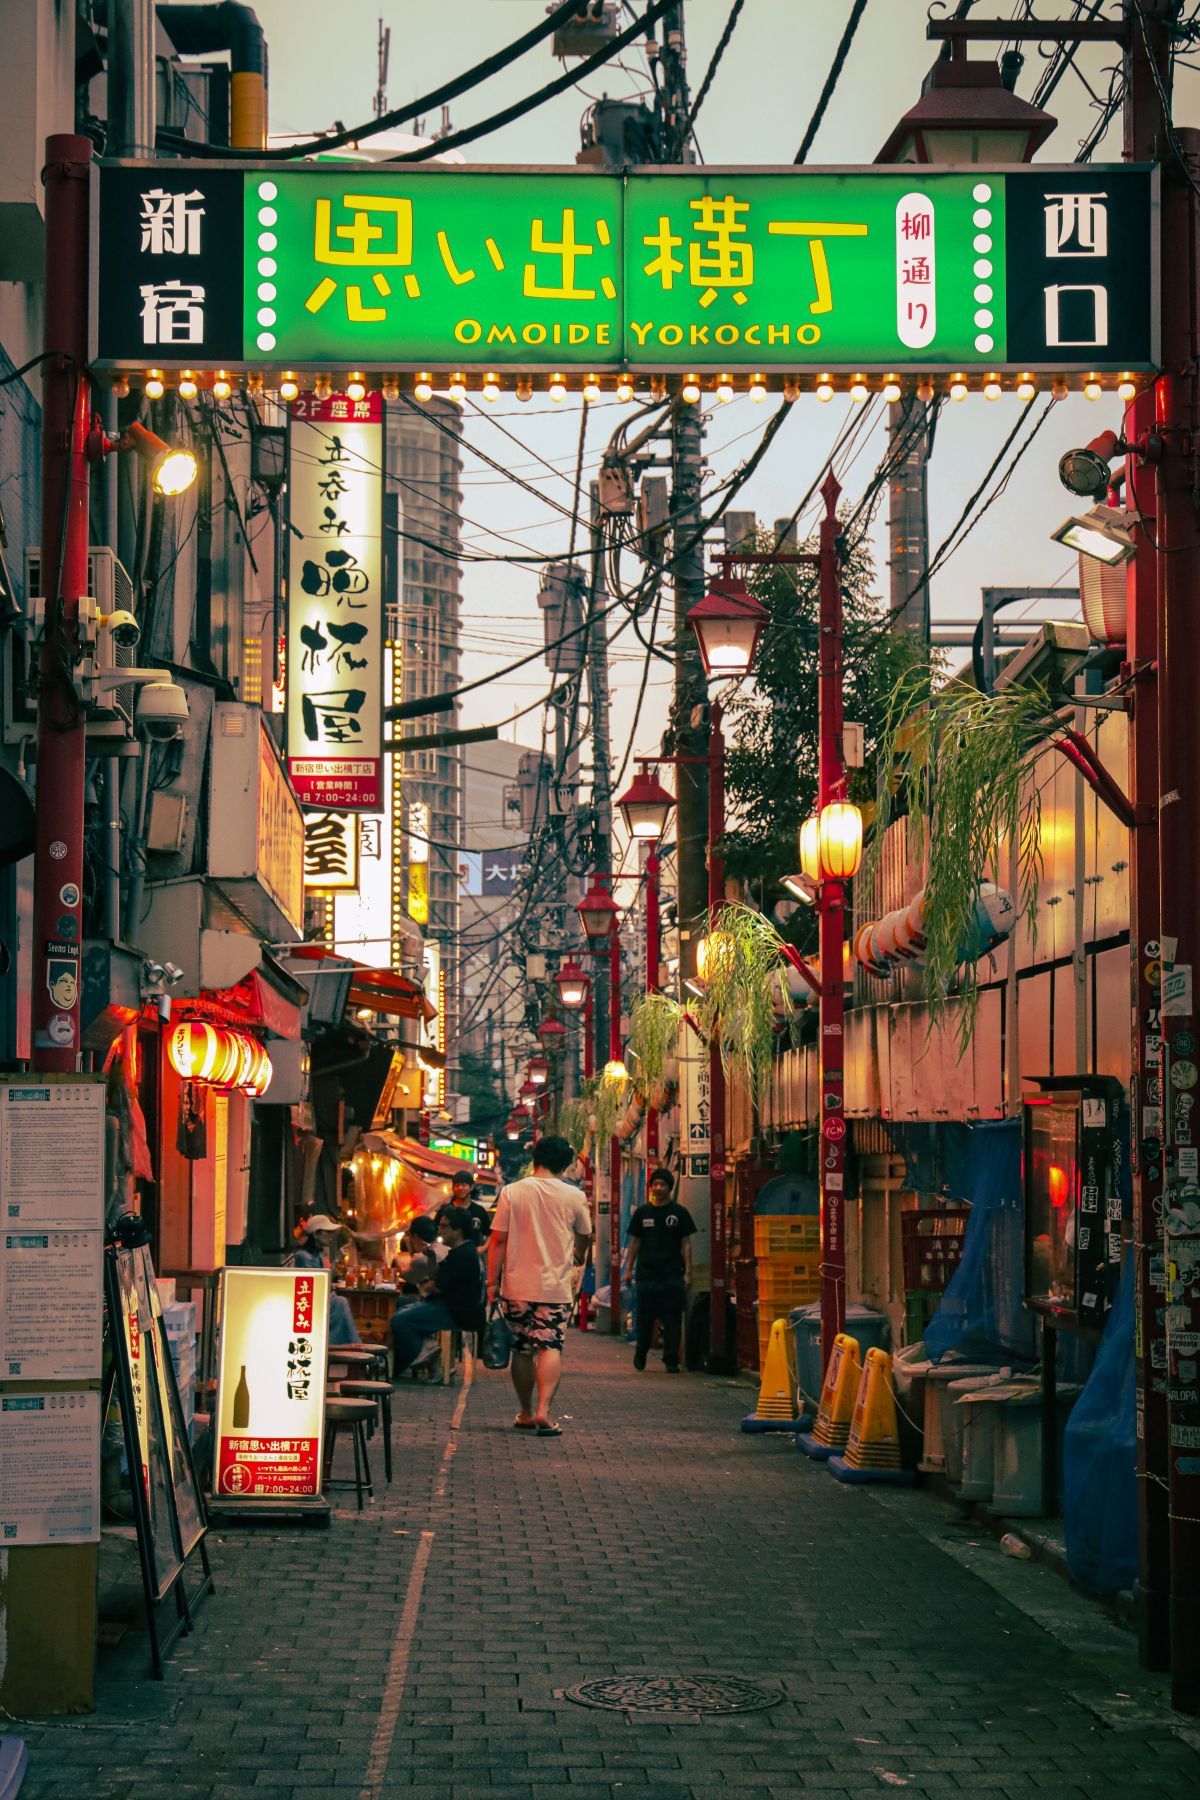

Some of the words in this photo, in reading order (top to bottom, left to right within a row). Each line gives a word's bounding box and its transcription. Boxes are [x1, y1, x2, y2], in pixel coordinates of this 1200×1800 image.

[139, 188, 206, 345] 新宿
[305, 193, 868, 322] 思い出横丁
[901, 212, 931, 330] 柳通り
[1044, 191, 1108, 347] 西口
[295, 763, 372, 775] 新宿思い出横丁店
[296, 1280, 312, 1329] 立呑み
[228, 1440, 311, 1452] 新宿思い出横丁店
